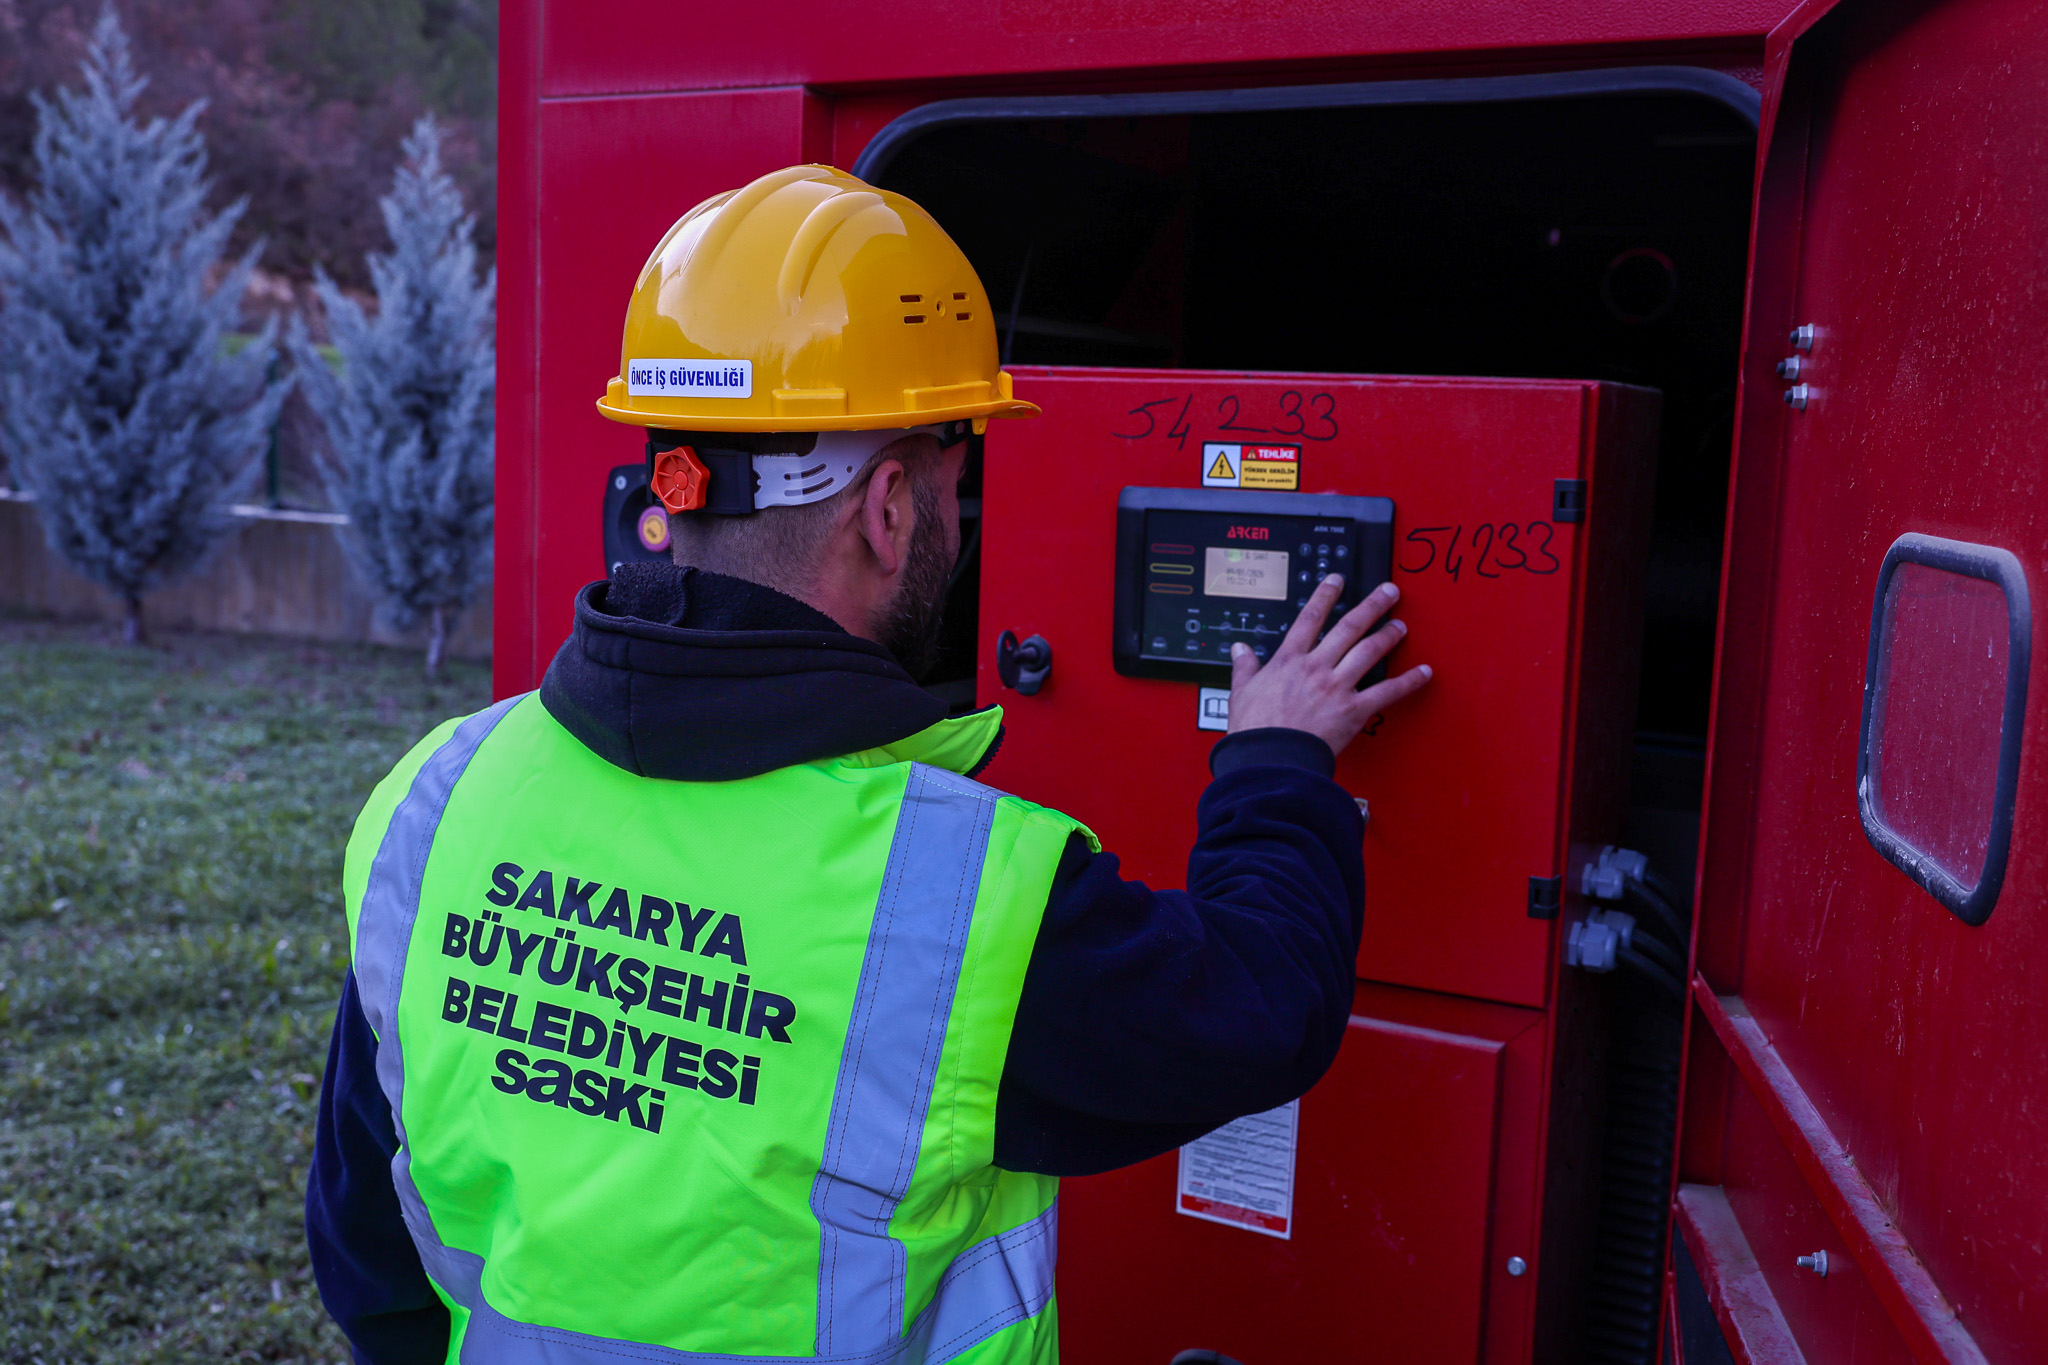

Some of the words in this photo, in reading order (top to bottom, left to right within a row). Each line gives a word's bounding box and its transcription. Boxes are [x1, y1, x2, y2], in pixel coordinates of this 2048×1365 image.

[631, 367, 652, 385] ÖNCE
[655, 366, 666, 389] İŞ
[670, 367, 744, 387] GÜVENLİĞİ
[1258, 448, 1296, 459] TEHLİKE
[1227, 526, 1269, 540] ARKEN
[1398, 521, 1560, 583] 54233
[485, 862, 748, 966] SAKARYA
[441, 909, 797, 1044] BÜYÜKŞEHİR
[441, 976, 762, 1106] BELEDİYESİ
